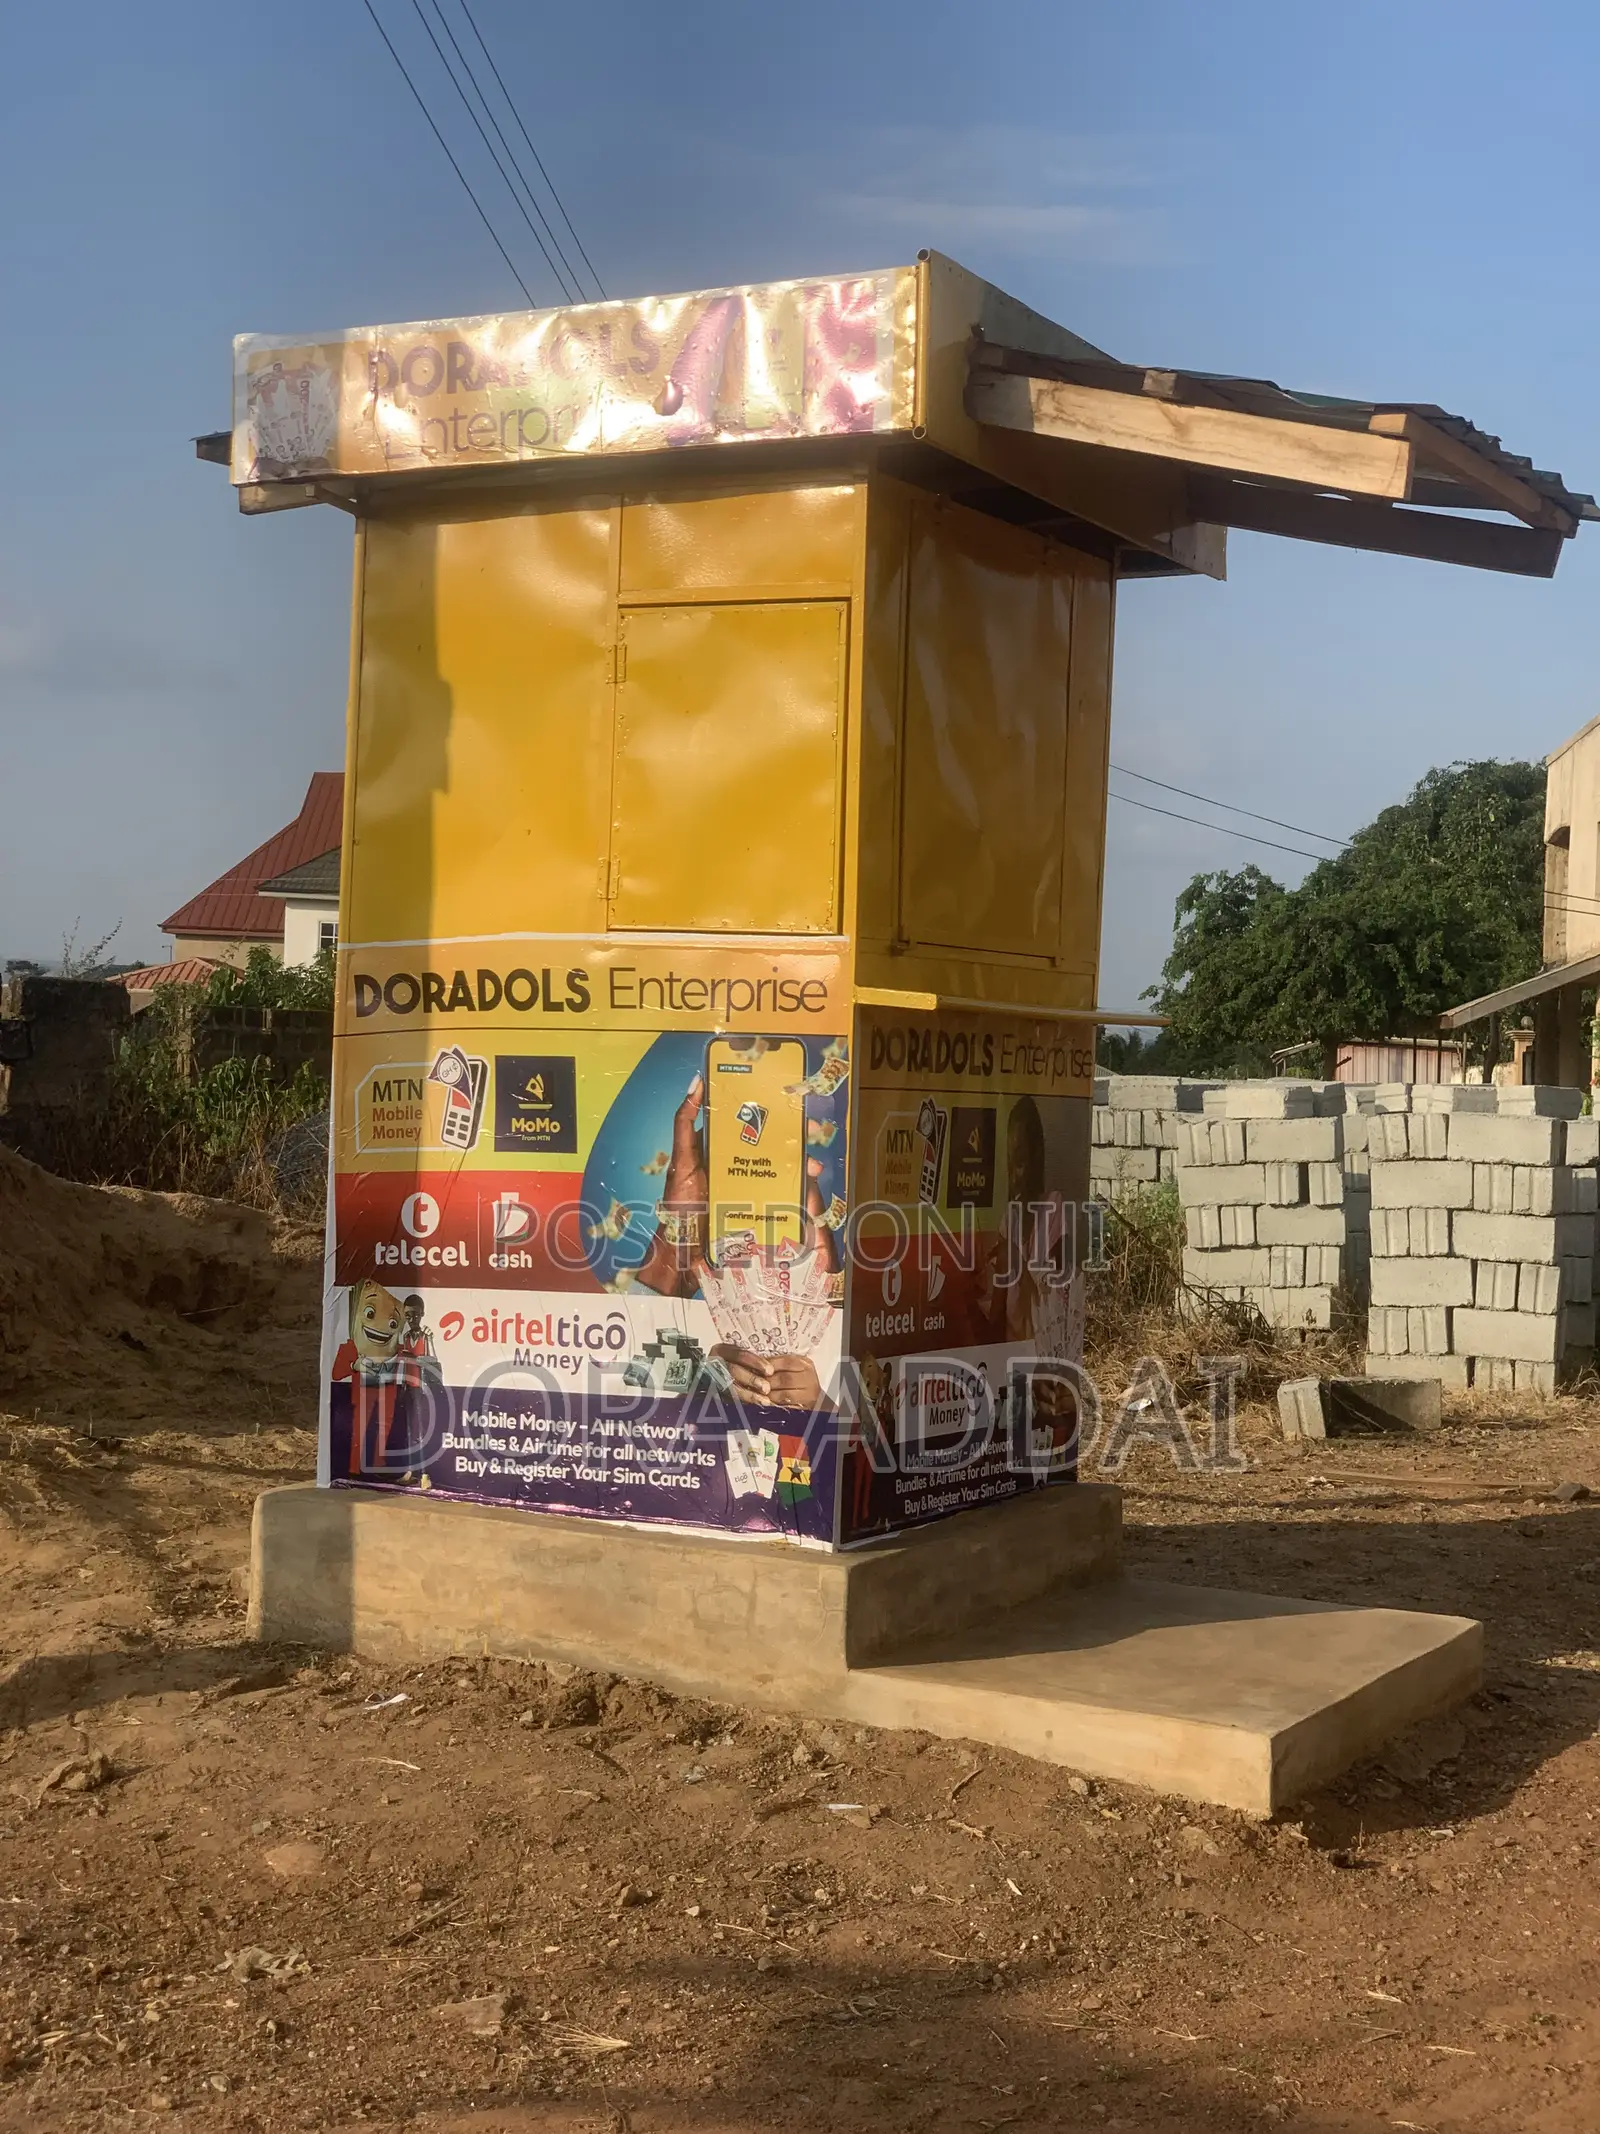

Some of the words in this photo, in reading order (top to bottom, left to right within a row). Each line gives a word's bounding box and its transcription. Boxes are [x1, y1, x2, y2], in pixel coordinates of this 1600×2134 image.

[353, 968, 592, 1018] DORADOLS
[609, 965, 828, 1023] Enterprise
[870, 1025, 994, 1077] DORADOLS
[1000, 1034, 1092, 1087] Enterprise
[372, 1077, 424, 1103] MTN
[372, 1105, 423, 1122] Mobile
[511, 1117, 561, 1133] MoMo
[372, 1125, 422, 1142] Money
[886, 1129, 914, 1154] MTN
[727, 1168, 748, 1177] MTN
[750, 1169, 777, 1179] MoMo
[733, 1156, 750, 1168] Pay
[751, 1158, 771, 1167] with
[956, 1171, 986, 1188] MoMo
[724, 1211, 754, 1220] Confirm
[755, 1213, 789, 1223] payment
[374, 1238, 470, 1267] telecel
[488, 1250, 533, 1269] cash
[865, 1307, 915, 1338] telecel
[923, 1312, 945, 1331] cash
[513, 1347, 584, 1375] Money
[461, 1410, 517, 1430] Mobile
[520, 1412, 577, 1437] Money
[590, 1419, 614, 1436] All
[618, 1420, 696, 1441] Network
[929, 1406, 965, 1427] Money
[441, 1432, 507, 1452] Bundles
[509, 1438, 520, 1452] &
[521, 1439, 582, 1457] Airtime
[584, 1442, 608, 1459] for
[613, 1444, 633, 1461] all
[636, 1448, 716, 1467] networks
[982, 1436, 1014, 1456] Network
[455, 1456, 488, 1477] Buy
[490, 1457, 501, 1474] &
[504, 1460, 570, 1483] Register
[571, 1463, 611, 1483] Your
[613, 1466, 646, 1485] Sim
[649, 1469, 701, 1489] Cards
[895, 1476, 927, 1495] Bundles
[929, 1474, 935, 1487] &
[936, 1468, 967, 1486] Airtime
[967, 1464, 980, 1480] for
[981, 1462, 990, 1477] all
[904, 1498, 921, 1520] Buy
[921, 1497, 927, 1511] &
[928, 1492, 961, 1513] Register
[961, 1487, 980, 1502] Your
[980, 1483, 995, 1498] Sim
[996, 1478, 1017, 1496] Cards
